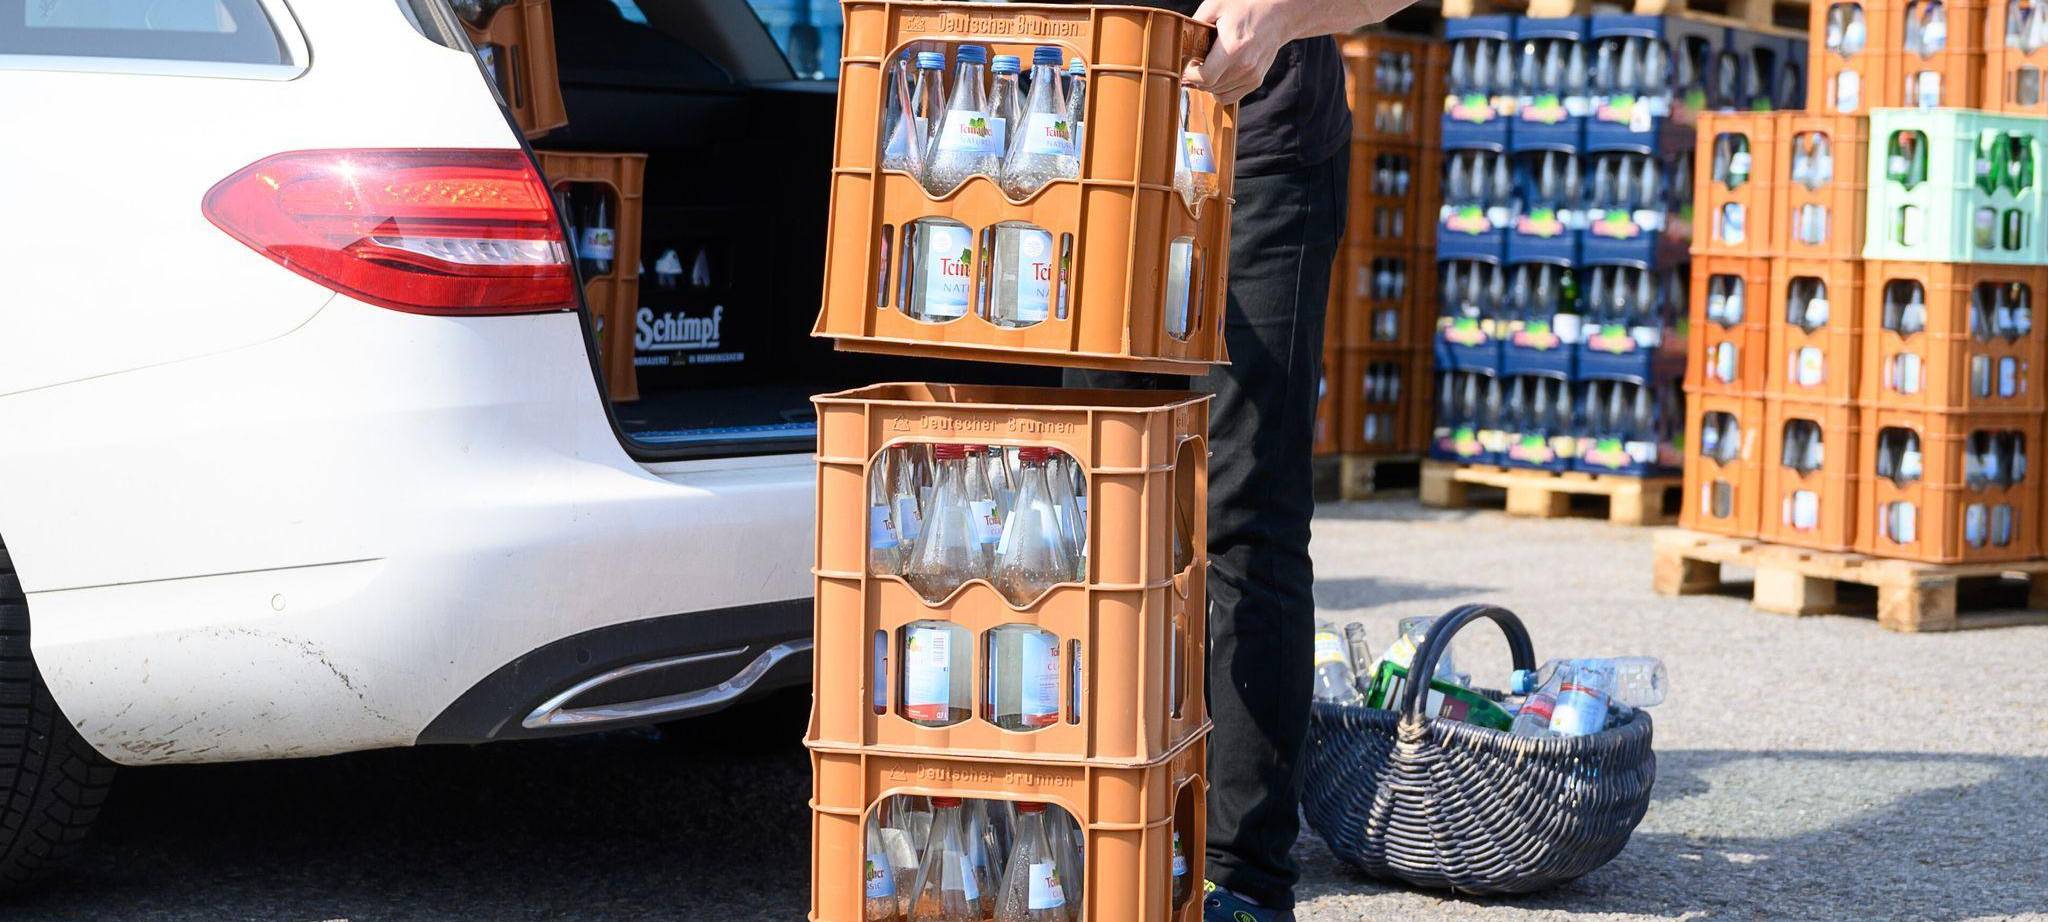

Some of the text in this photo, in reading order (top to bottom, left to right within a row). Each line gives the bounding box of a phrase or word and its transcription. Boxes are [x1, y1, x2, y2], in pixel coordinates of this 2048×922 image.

[938, 12, 1079, 36] Deutscher Brunnen
[635, 304, 723, 351] Schimpf
[920, 415, 1076, 434] Deutscher Brunnen
[916, 764, 1074, 788] Deutscher Brunnen
